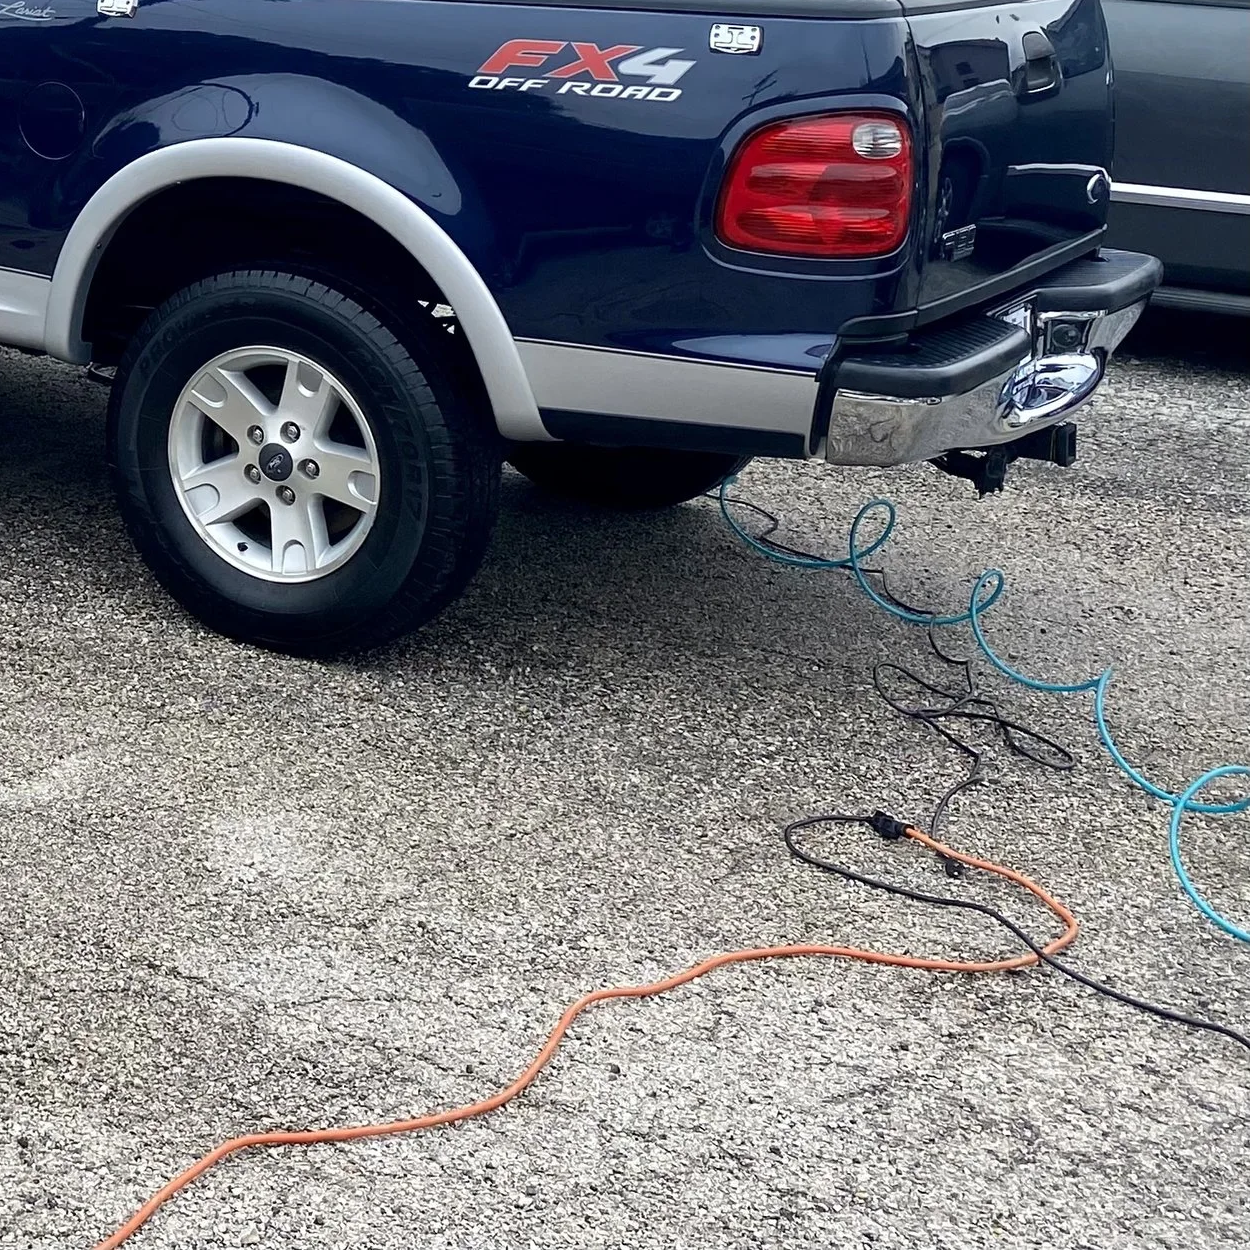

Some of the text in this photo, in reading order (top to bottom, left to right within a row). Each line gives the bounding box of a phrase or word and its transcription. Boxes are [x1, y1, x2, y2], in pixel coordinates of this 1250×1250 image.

[476, 38, 697, 86] FX4
[468, 76, 683, 102] OFF ROAD
